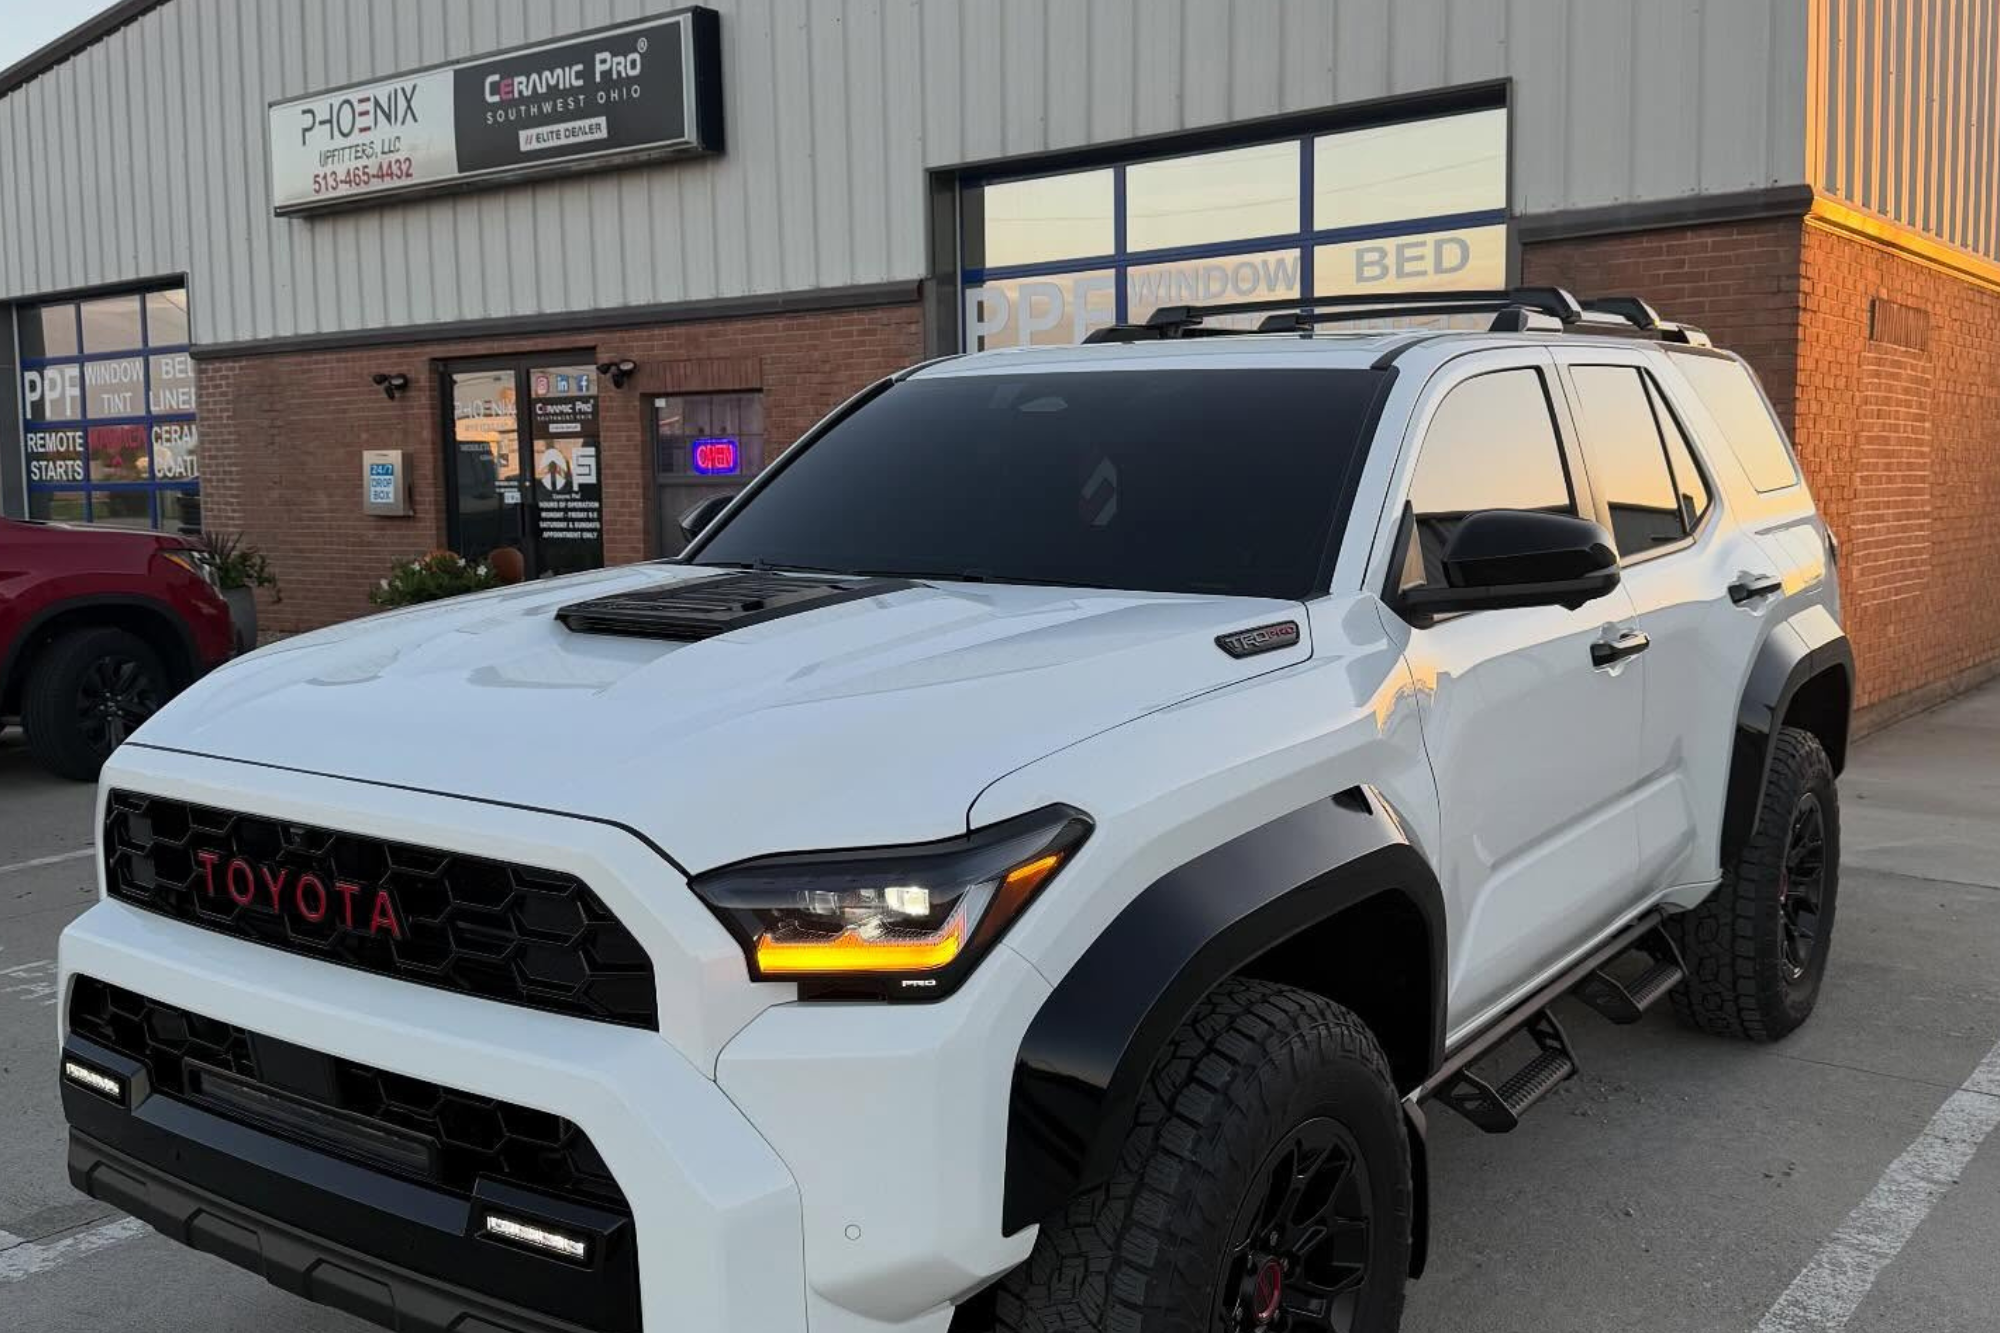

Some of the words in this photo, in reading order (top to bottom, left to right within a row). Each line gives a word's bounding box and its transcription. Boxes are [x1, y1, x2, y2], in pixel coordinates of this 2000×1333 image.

[484, 63, 584, 103] CERAMIC
[301, 83, 418, 147] PHOENIX
[486, 95, 585, 125] SOUTHWEST
[597, 85, 641, 105] OHIO
[381, 136, 401, 156] LLC
[535, 129, 562, 144] ELITE
[564, 123, 602, 139] DEALER
[313, 156, 414, 195] 513-465-4432
[1355, 236, 1470, 284] BED
[1129, 255, 1300, 305] WINDOW
[966, 276, 1115, 352] PPF
[84, 360, 143, 386] WINDOW
[24, 368, 79, 419] PPF
[101, 392, 133, 414] TINT
[27, 431, 84, 453] REMOTE
[697, 444, 735, 469] OPEN
[31, 460, 84, 481] STARTS
[371, 465, 393, 475] 24/7
[371, 478, 392, 488] DROP
[373, 490, 391, 500] BOX
[582, 531, 598, 539] ONLY
[198, 849, 402, 938] TOYOTA
